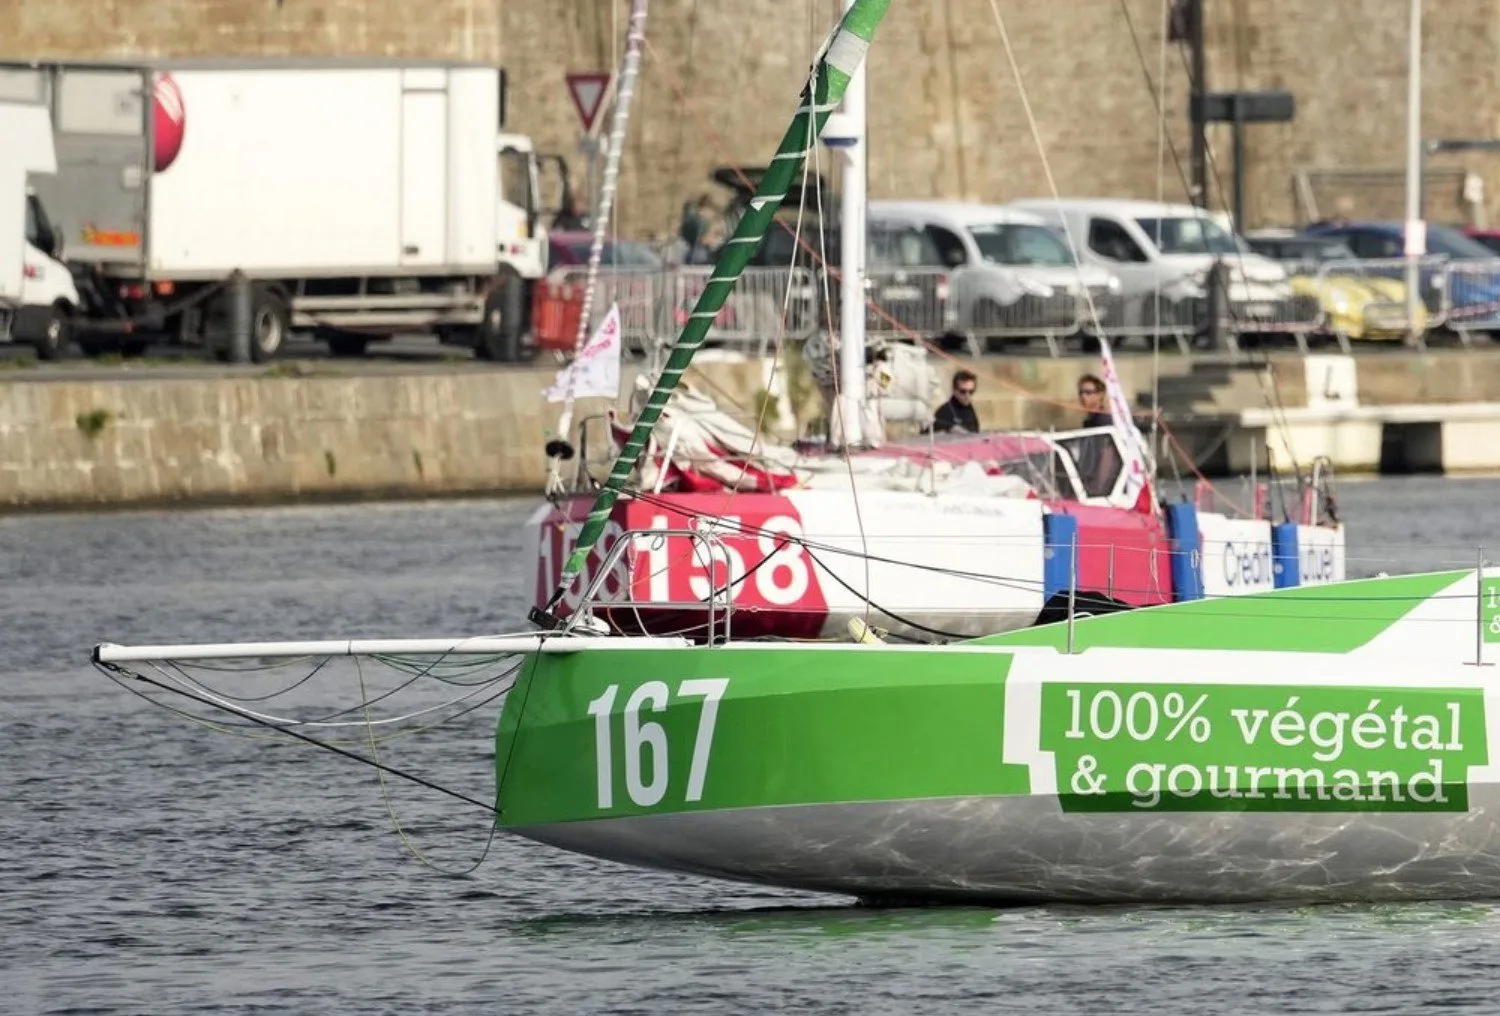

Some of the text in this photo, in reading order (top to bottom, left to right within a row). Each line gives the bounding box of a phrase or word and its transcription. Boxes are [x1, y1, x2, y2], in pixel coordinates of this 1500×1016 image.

[633, 514, 809, 605] 158
[587, 678, 730, 809] 167
[1064, 689, 1463, 762] 100% végétal
[1070, 754, 1449, 809] & gourmand
